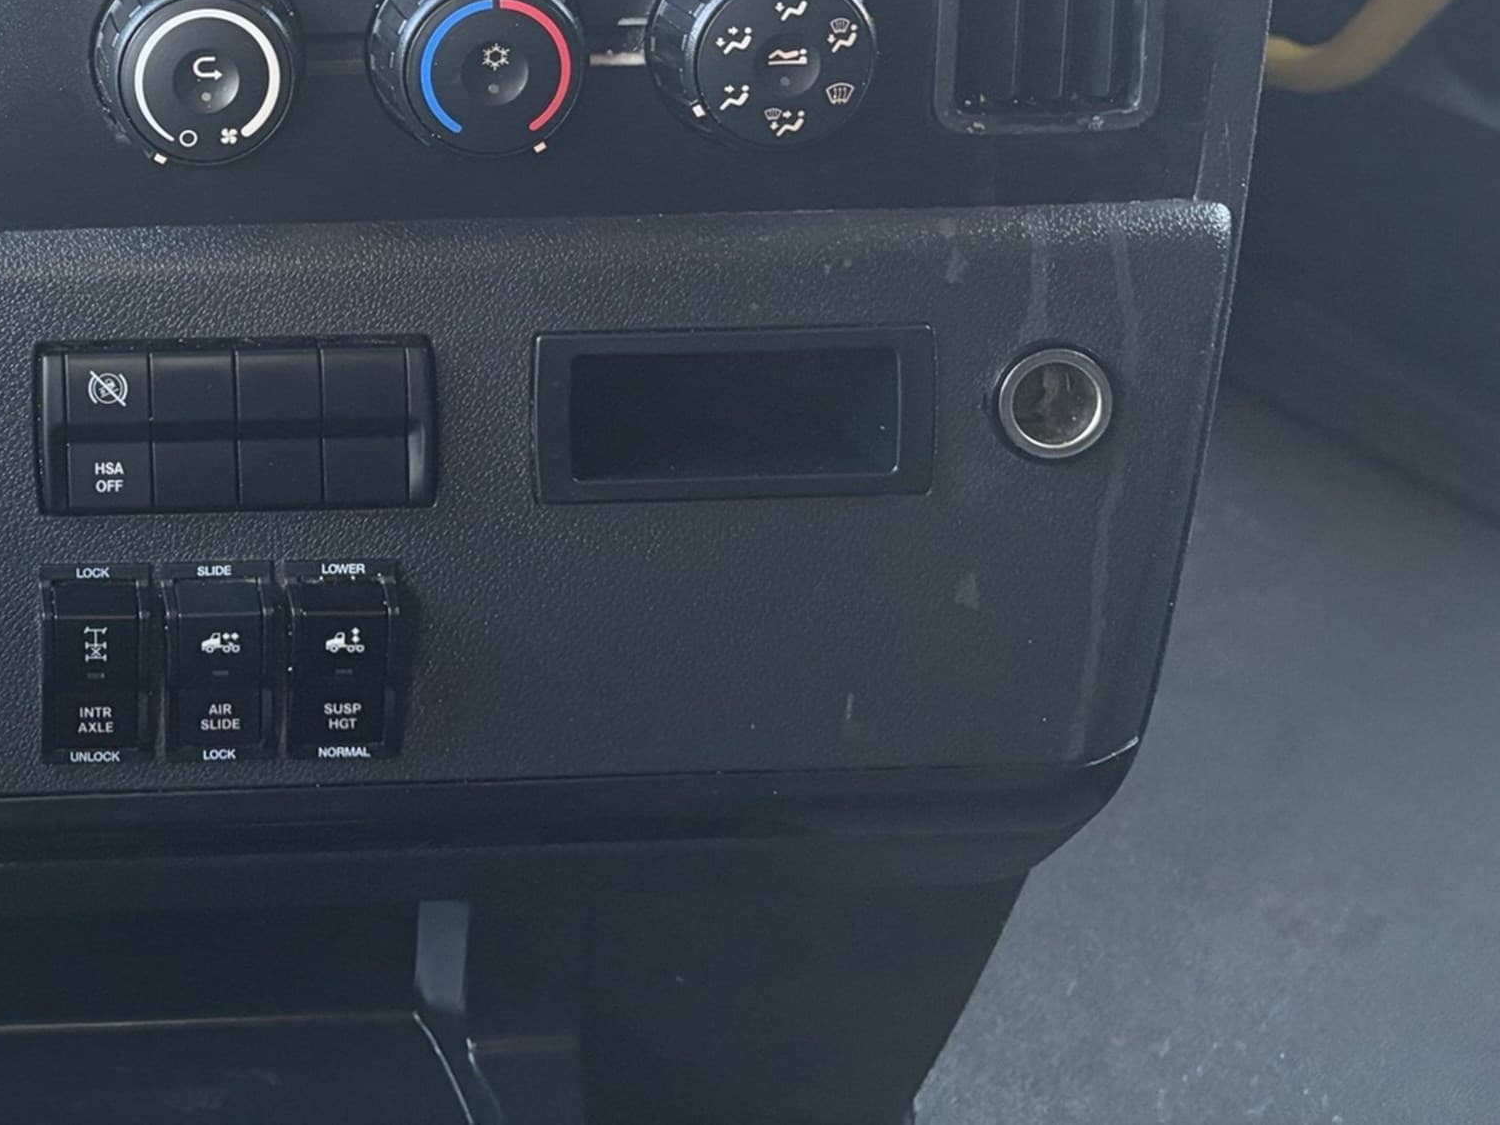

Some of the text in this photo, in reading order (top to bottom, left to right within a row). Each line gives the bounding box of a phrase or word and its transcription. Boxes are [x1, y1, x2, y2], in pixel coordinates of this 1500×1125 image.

[94, 462, 124, 475] HSA
[95, 479, 124, 493] OFF
[76, 567, 110, 579] LOCK
[197, 565, 232, 577] SLIDE
[321, 563, 365, 575] LOWER
[79, 707, 113, 719] INTR
[208, 703, 233, 716] AIR
[324, 703, 362, 715] SUSP
[77, 721, 114, 734] AXLE
[200, 718, 241, 731] SLIDE
[328, 717, 357, 730] HGT
[70, 751, 120, 763] UNLOCK
[203, 748, 236, 761] LOCK
[318, 746, 371, 758] NORMAL
